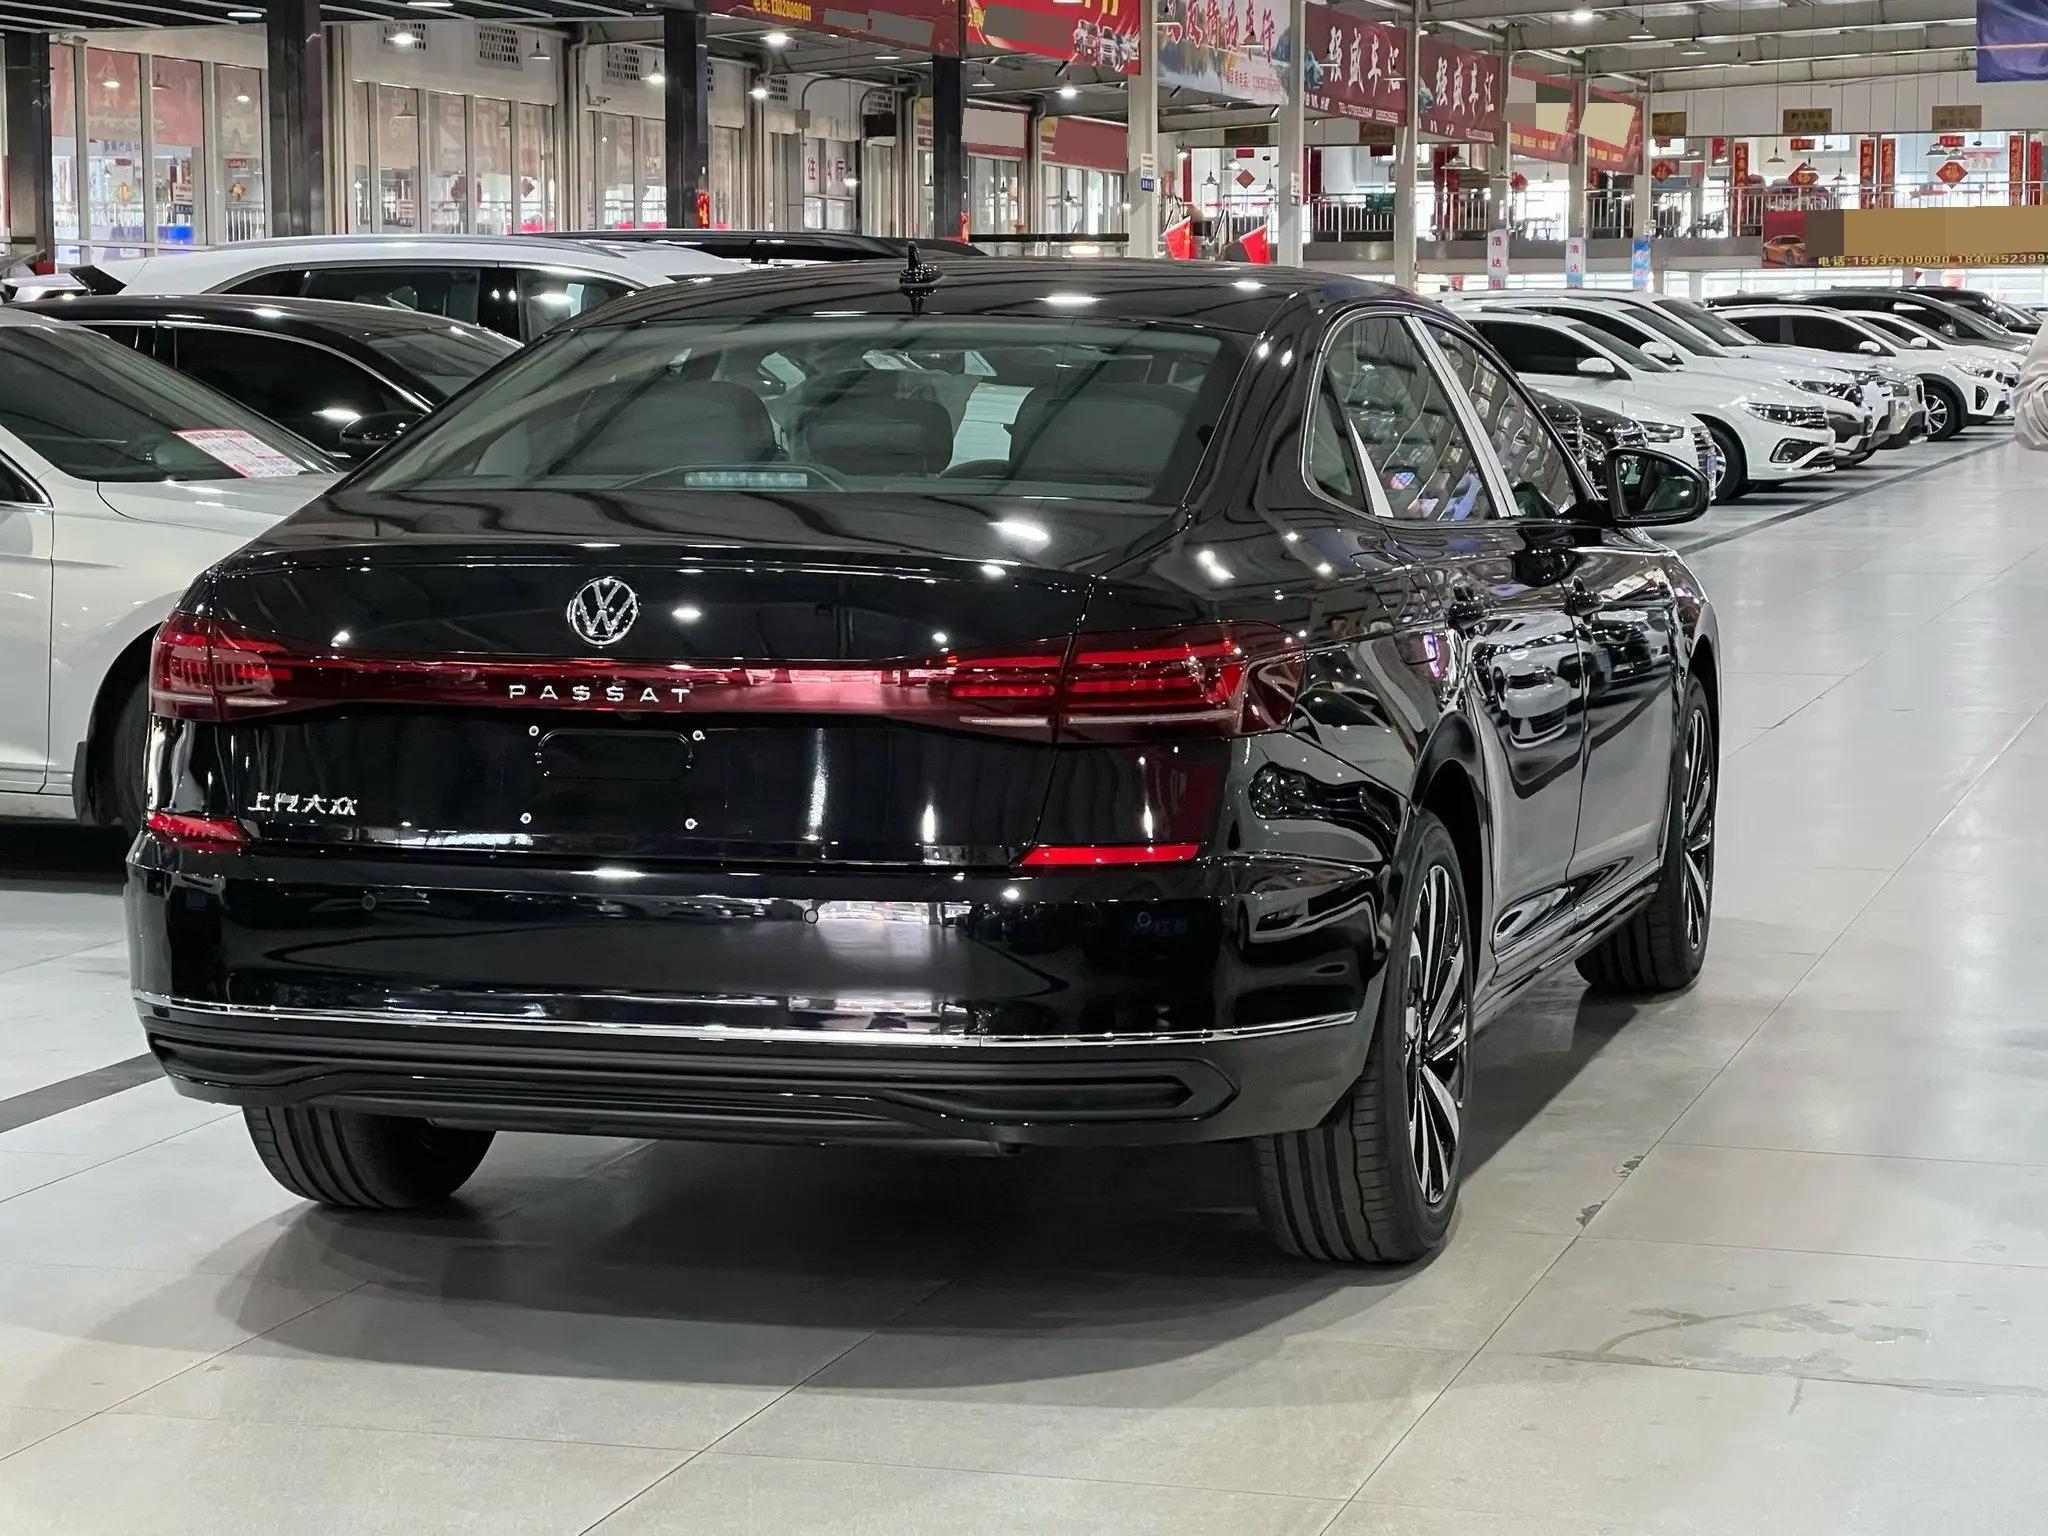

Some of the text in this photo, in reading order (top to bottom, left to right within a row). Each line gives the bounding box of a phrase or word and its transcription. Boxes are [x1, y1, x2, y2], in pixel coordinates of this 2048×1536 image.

[1956, 252, 2048, 264] 1840352399
[508, 683, 691, 704] PASSAT
[247, 791, 358, 818] 上汽大众
